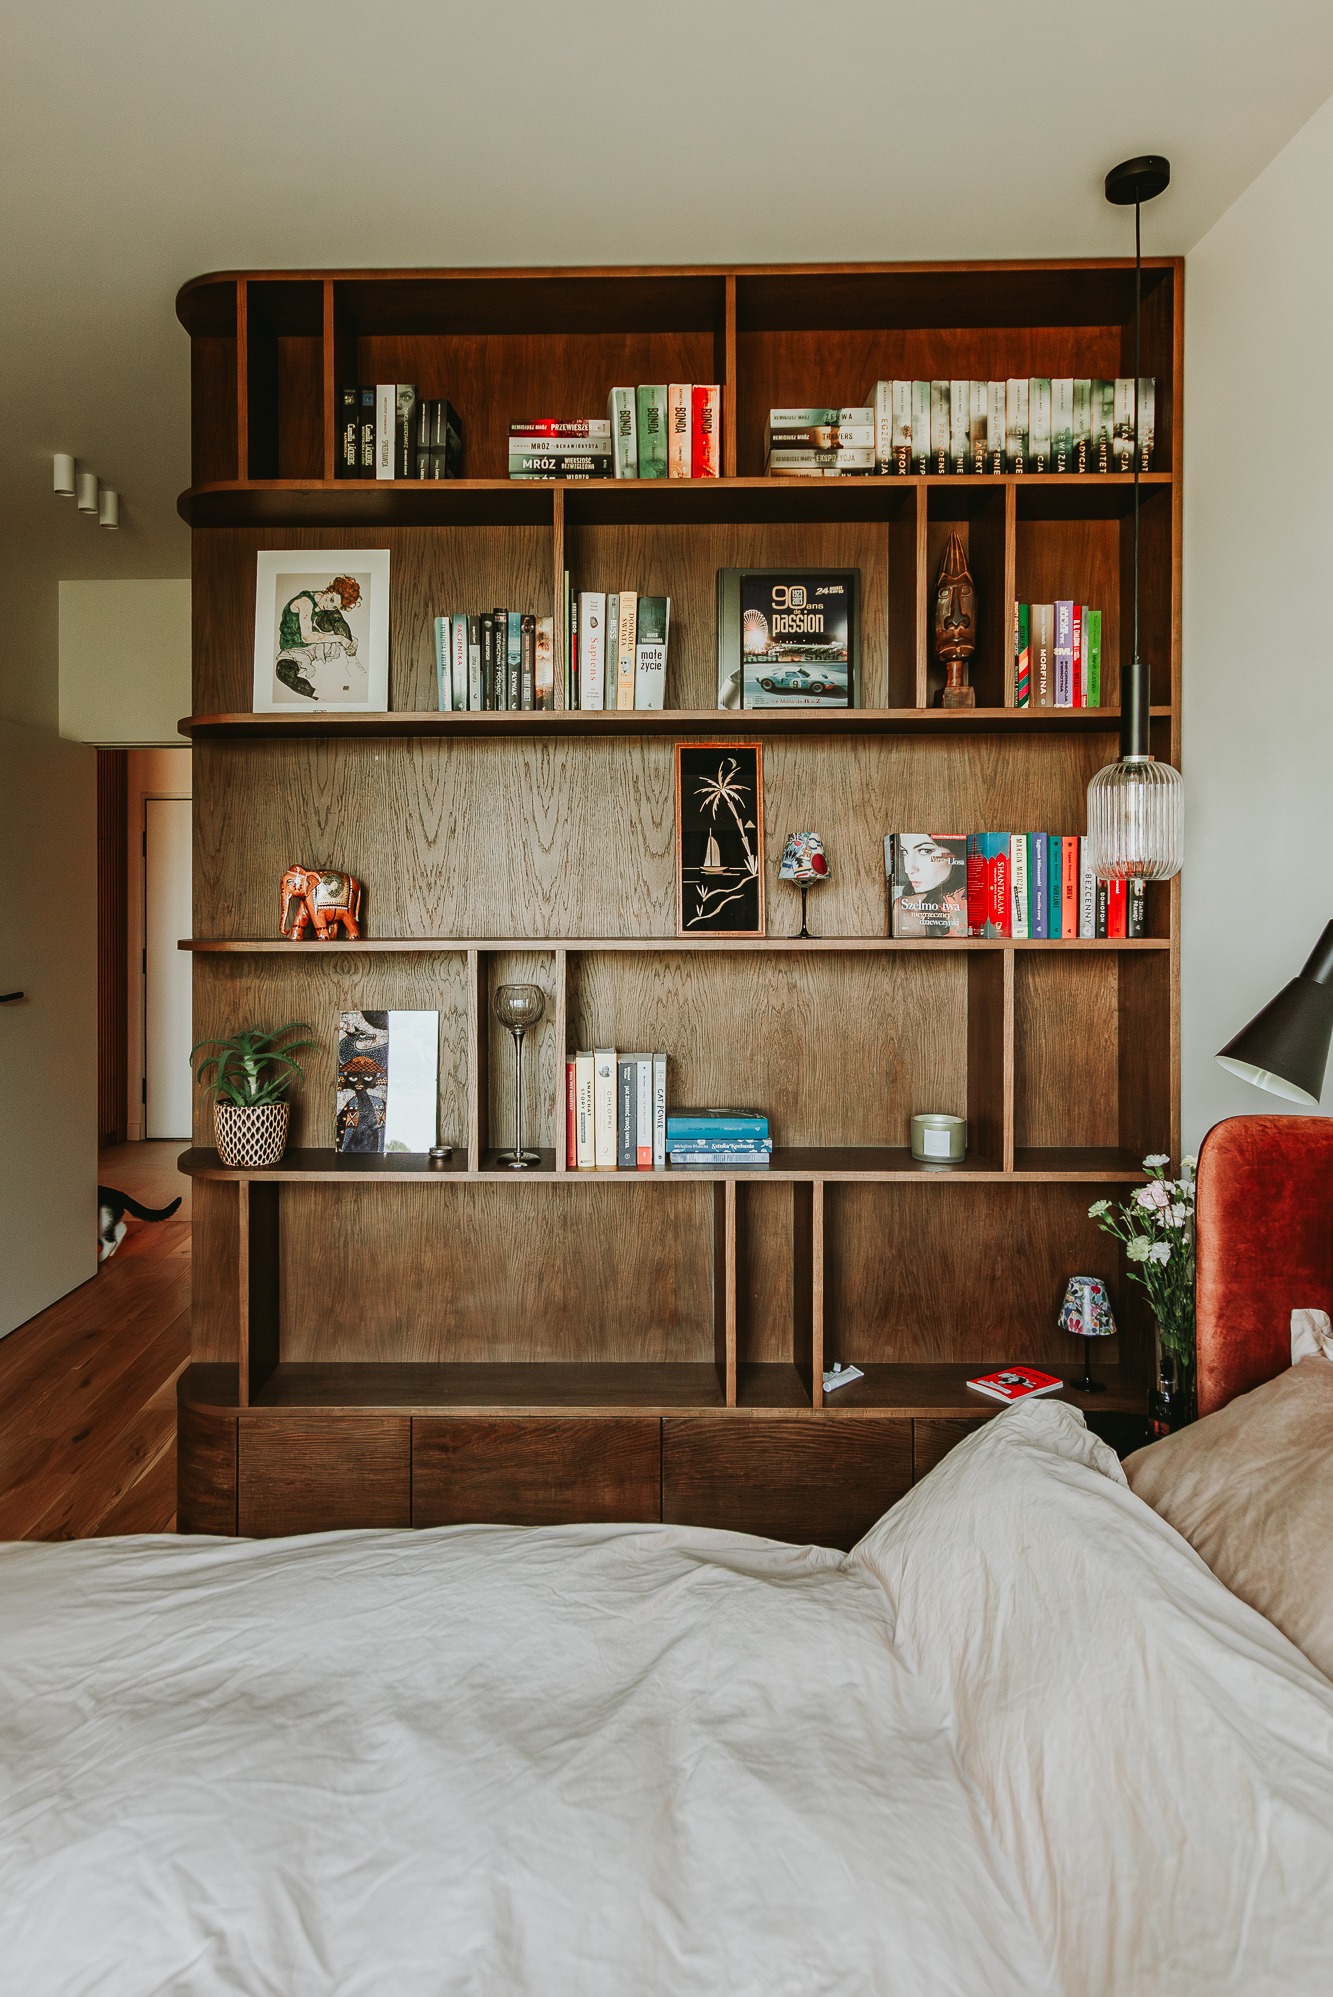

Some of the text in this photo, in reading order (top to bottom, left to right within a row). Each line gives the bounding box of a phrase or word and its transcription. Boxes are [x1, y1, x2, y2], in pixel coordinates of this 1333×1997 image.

[347, 423, 355, 442] Camilla
[365, 424, 374, 442] Camilla
[619, 410, 632, 437] BONDA
[647, 407, 659, 434] BONDA
[674, 406, 687, 433] BONDA
[700, 408, 712, 435] BONDA
[530, 442, 550, 450] MRÓZ
[880, 418, 888, 475] EGZEKUCJA
[898, 441, 906, 475] YROK
[975, 441, 983, 474] AFEKT
[1057, 433, 1066, 472] EWIZJA
[522, 456, 556, 470] MRÓZ
[771, 585, 807, 610] 90
[815, 587, 830, 596] 24
[609, 619, 617, 639] BUSS
[627, 613, 635, 652] DOOKOŁA
[772, 609, 824, 637] passion
[588, 637, 599, 681] Sapiens
[640, 659, 662, 673] życie
[641, 648, 663, 660] małe
[494, 671, 502, 696] POCIĄGU
[792, 680, 799, 689] 9
[997, 861, 1005, 914] SHANTARAM
[1016, 866, 1024, 894] MATCZAK
[1052, 884, 1060, 909] UWIKŁANIE
[1084, 873, 1092, 925] BEZCENNY
[656, 1105, 665, 1129] POWER
